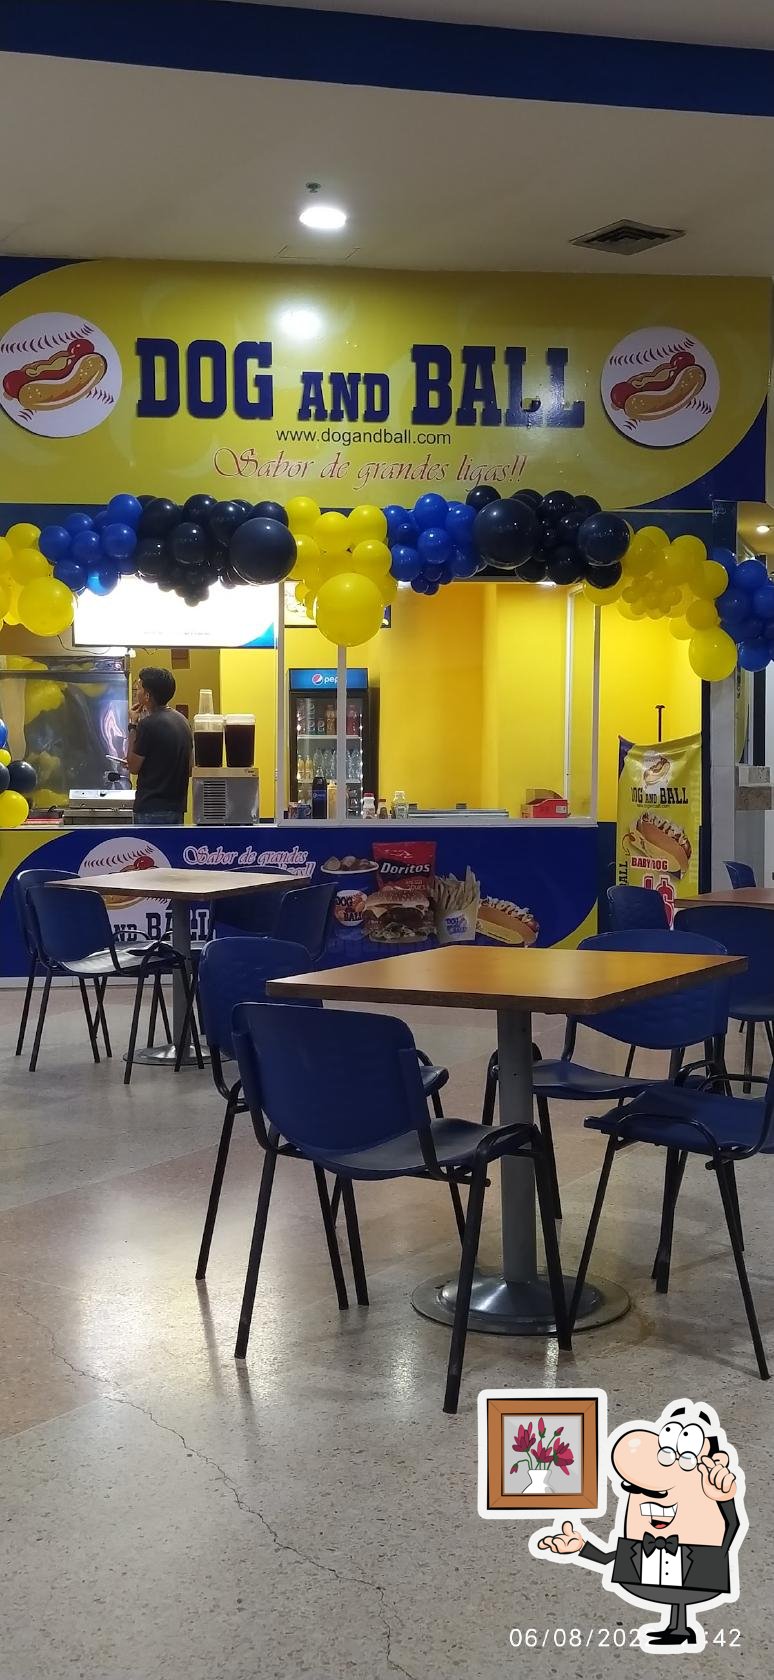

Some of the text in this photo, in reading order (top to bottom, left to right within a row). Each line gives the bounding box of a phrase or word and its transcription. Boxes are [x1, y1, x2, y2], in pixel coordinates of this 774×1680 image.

[135, 338, 585, 428] DOG AND BALL
[276, 428, 451, 446] www.dogandball.com
[214, 448, 528, 492] Sabor de grandes ligas!!
[660, 788, 688, 804] BALL
[183, 846, 308, 866] Sabor de grandes
[631, 857, 650, 868] BABY
[380, 862, 431, 874] Doritos
